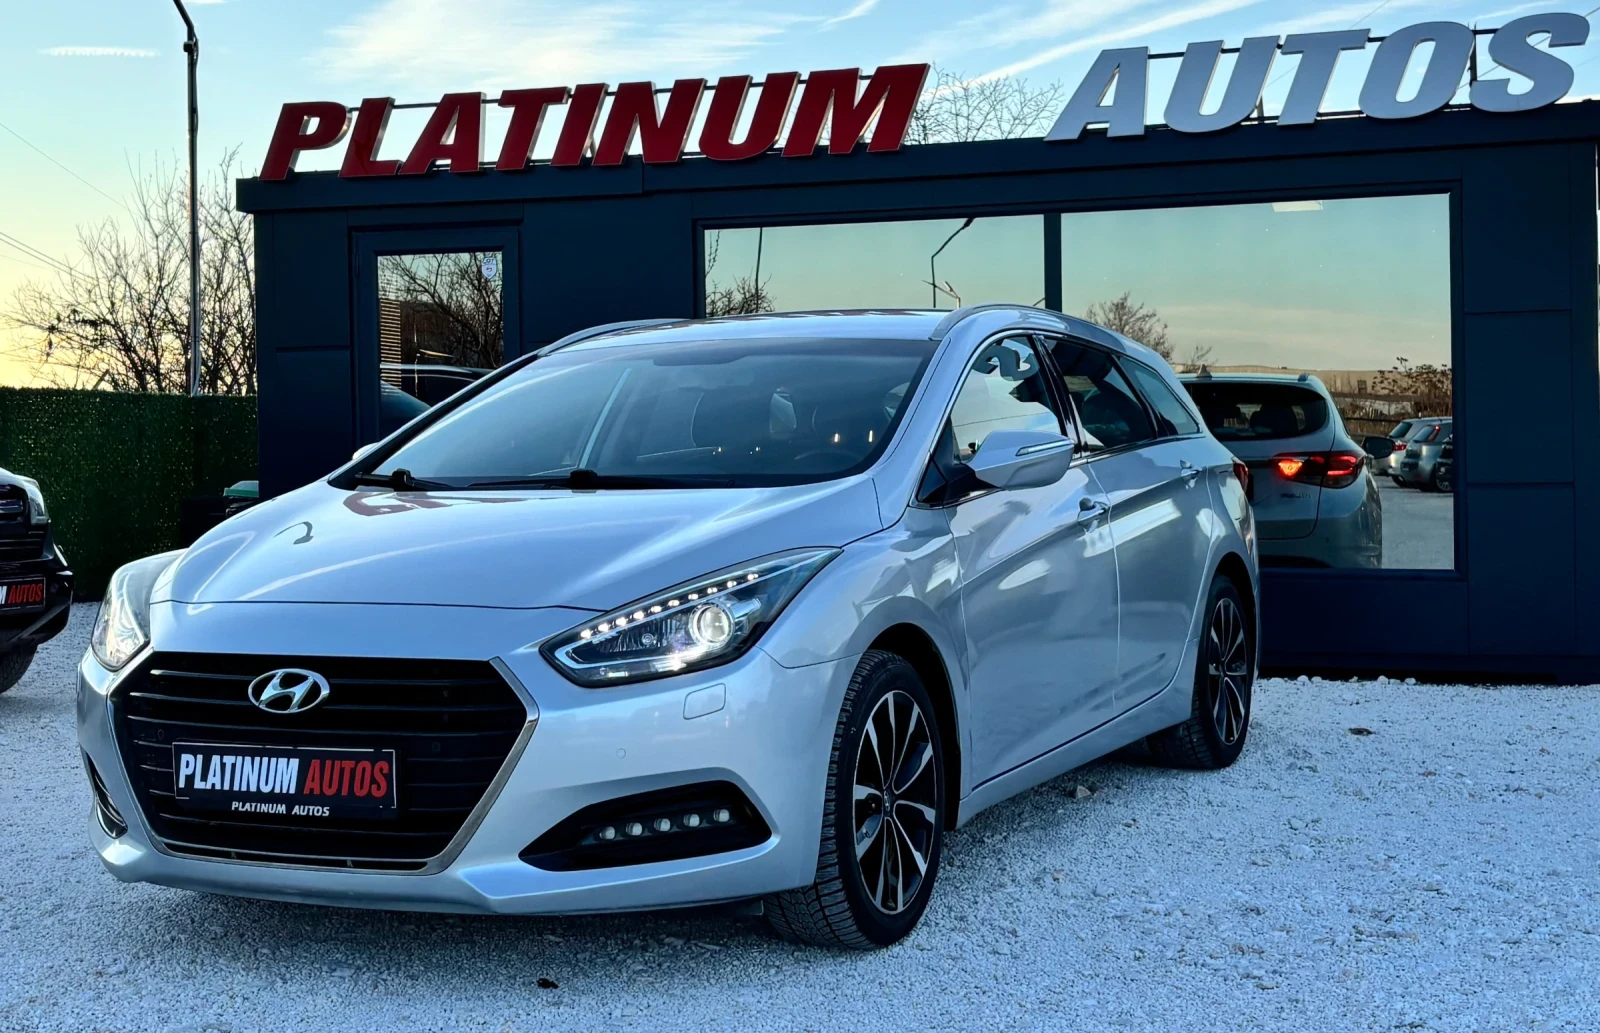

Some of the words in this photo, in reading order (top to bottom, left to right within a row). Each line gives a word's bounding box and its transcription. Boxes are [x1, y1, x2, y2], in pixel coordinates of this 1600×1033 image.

[259, 63, 931, 181] PLATINUM
[1044, 12, 1590, 142] AUTOS
[8, 584, 43, 604] AUTOS
[178, 753, 300, 794] PLATINUM
[303, 759, 389, 797] AUTOS
[231, 801, 286, 815] PLATINUM
[291, 805, 330, 816] AUTOS
